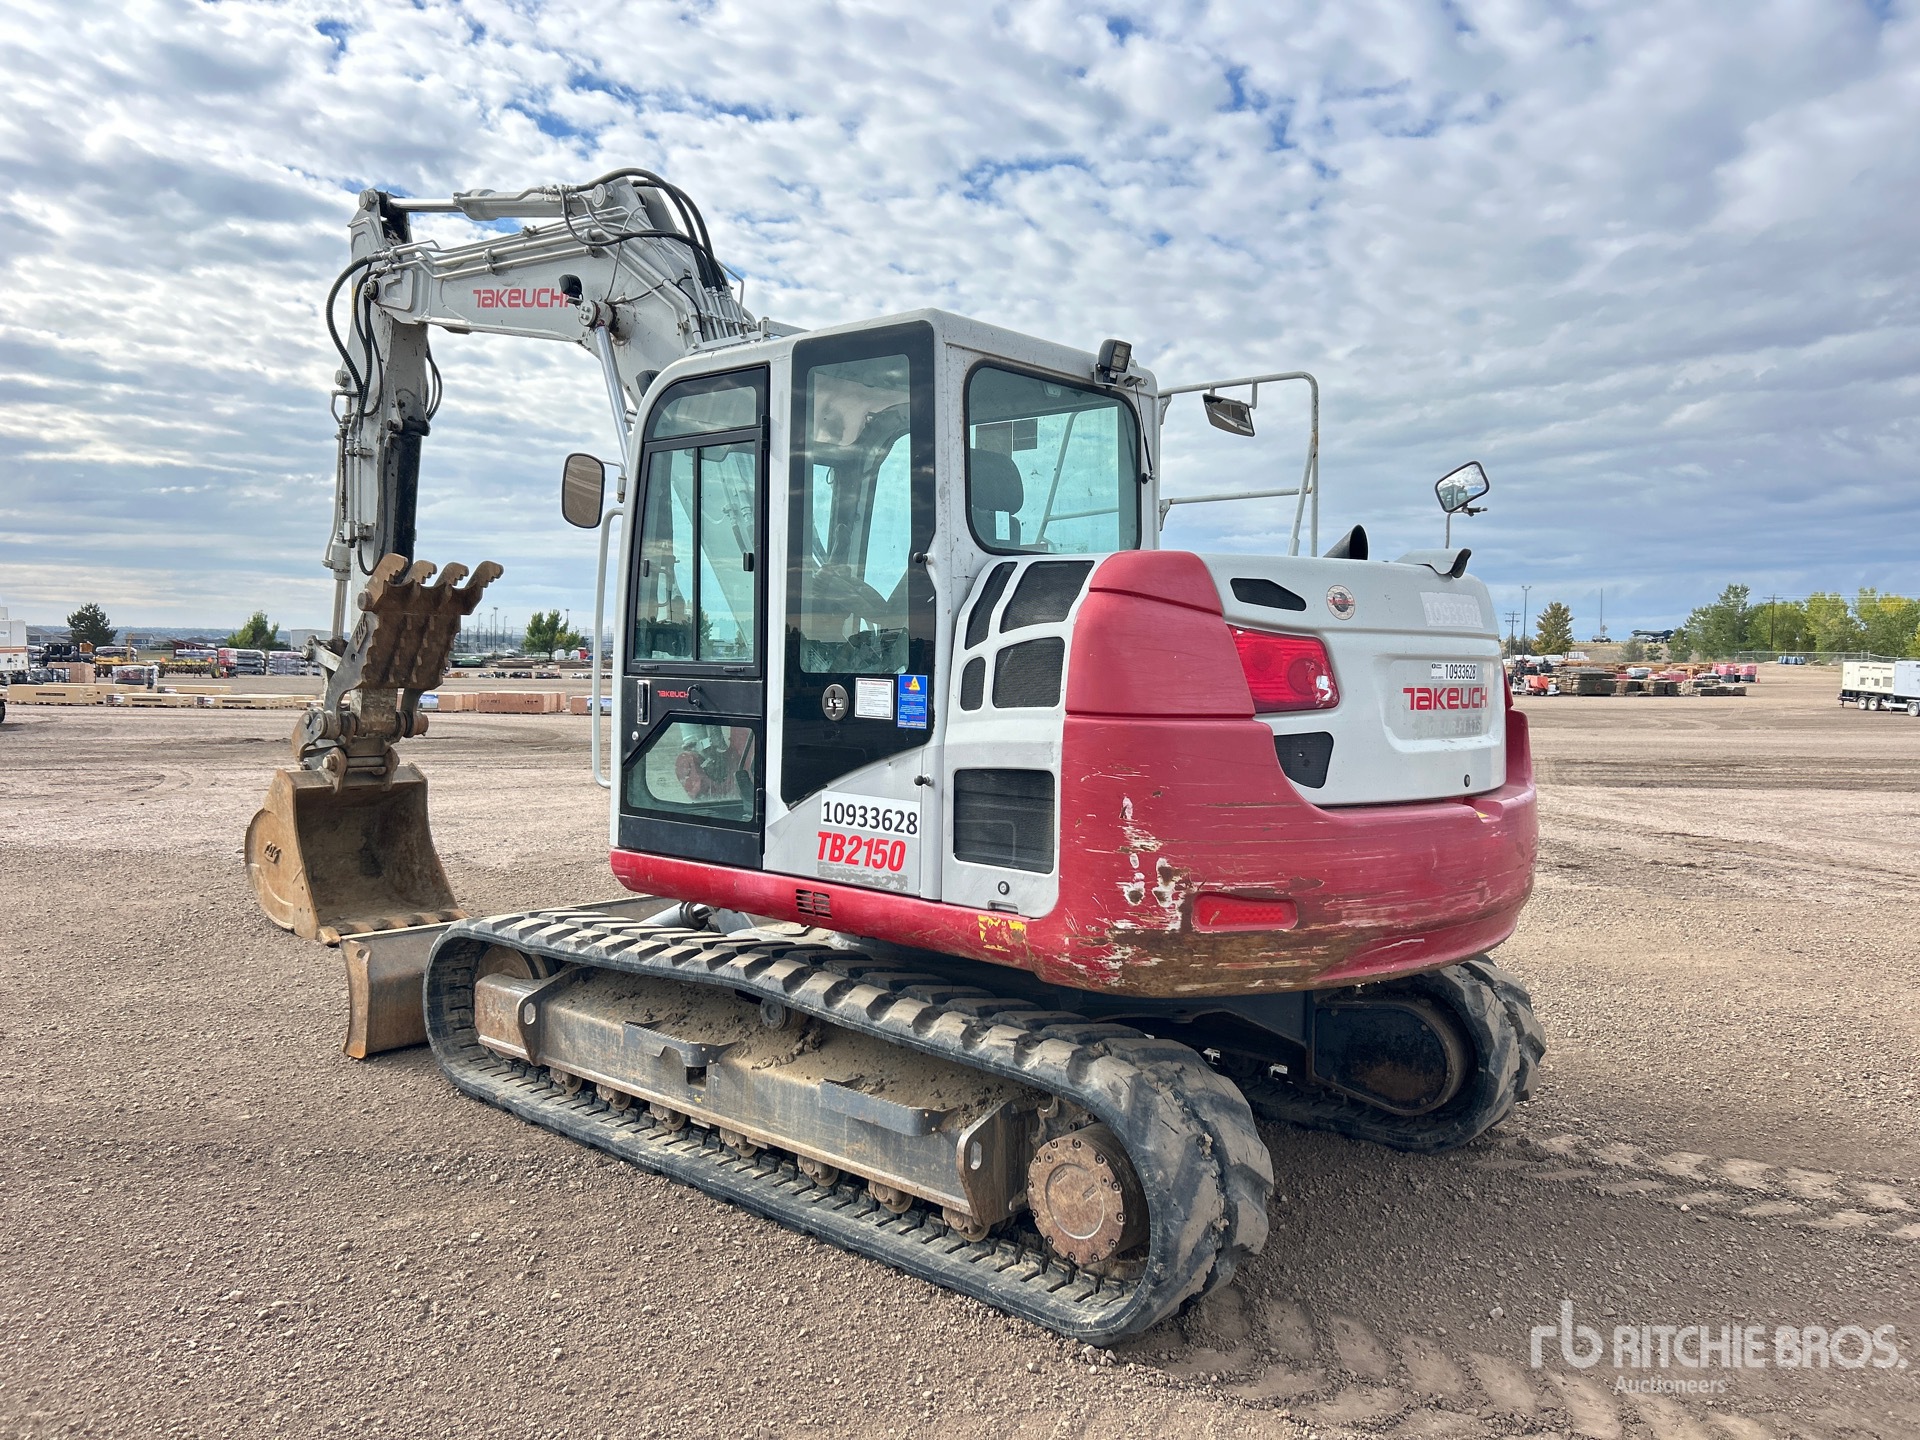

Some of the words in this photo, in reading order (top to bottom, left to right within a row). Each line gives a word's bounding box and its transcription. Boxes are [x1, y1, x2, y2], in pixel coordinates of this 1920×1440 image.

[1445, 664, 1477, 679] 10933628
[657, 690, 689, 698] TAKEUCH
[1403, 687, 1488, 710] TAKEUCH
[822, 800, 918, 835] 10933628
[817, 831, 906, 872] TB2150
